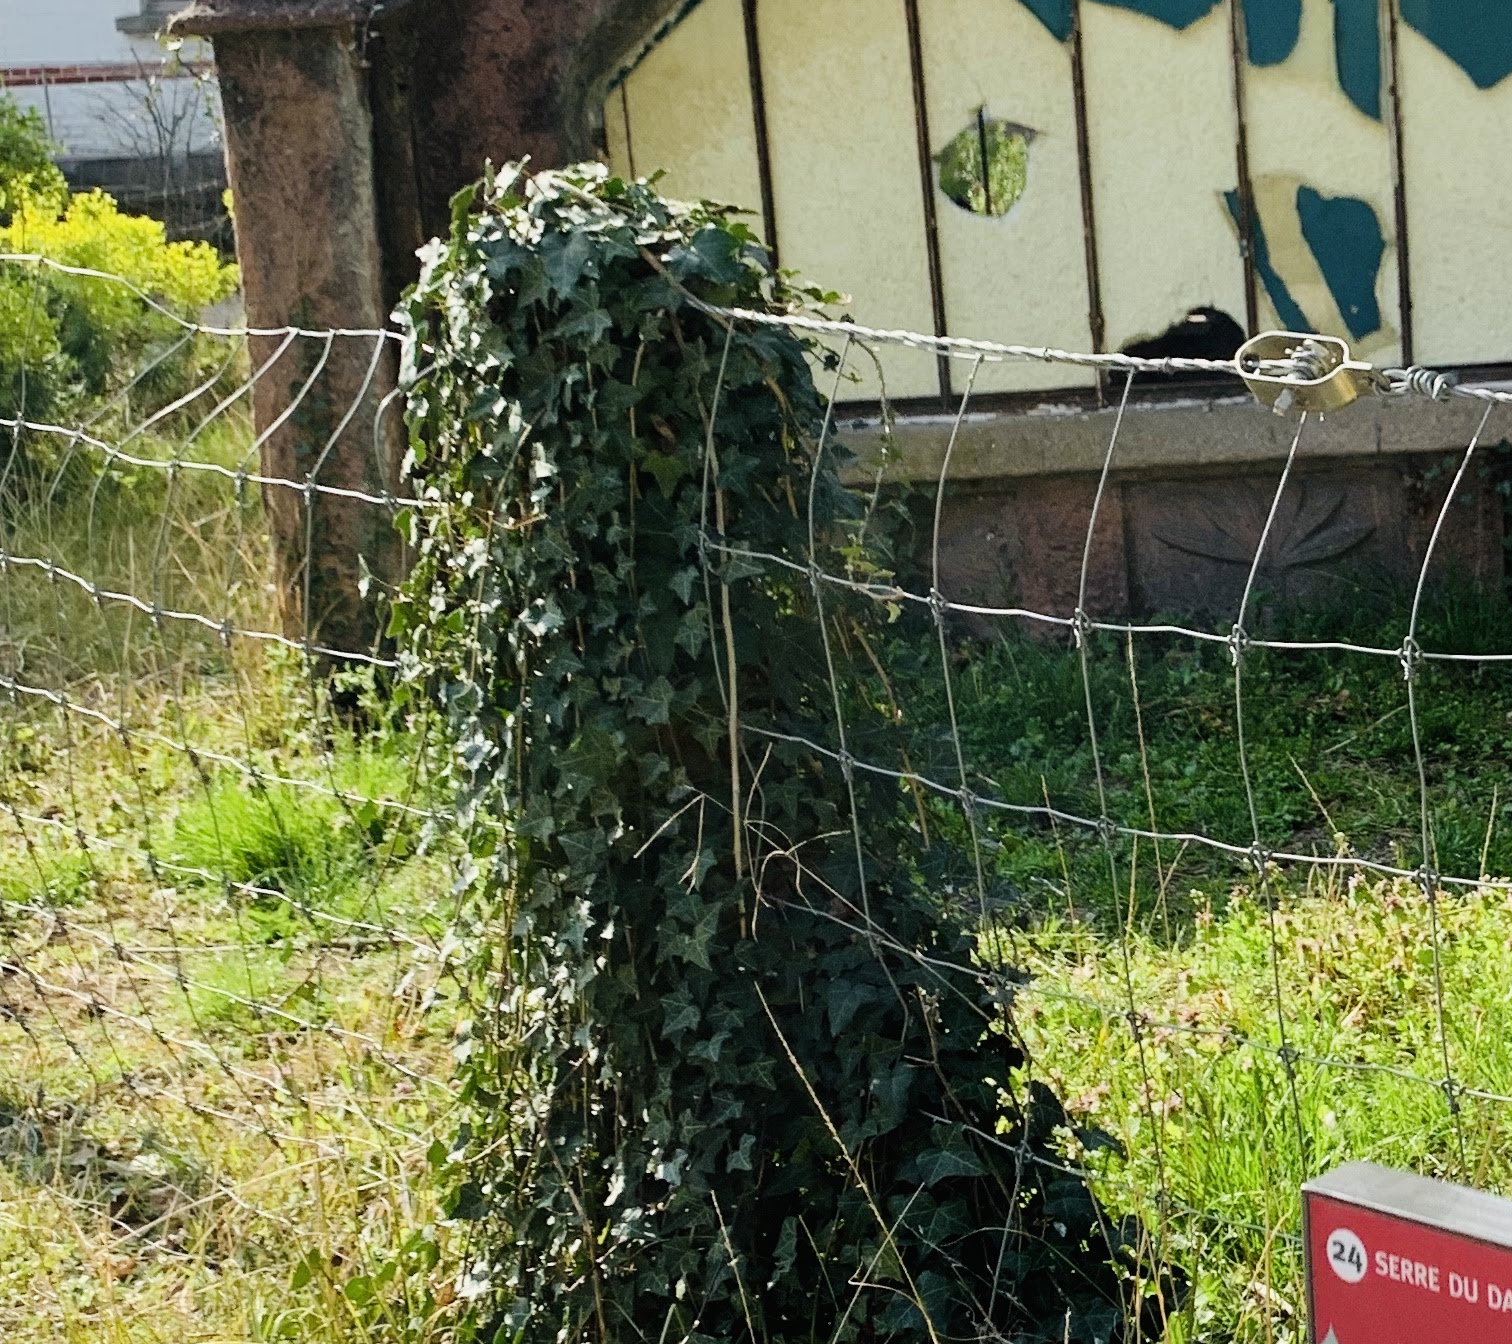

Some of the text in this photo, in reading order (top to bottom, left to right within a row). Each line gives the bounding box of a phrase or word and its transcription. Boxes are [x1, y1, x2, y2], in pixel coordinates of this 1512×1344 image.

[1332, 1240, 1363, 1274] 24
[1374, 1250, 1441, 1293] SERRE
[1448, 1271, 1479, 1304] DU
